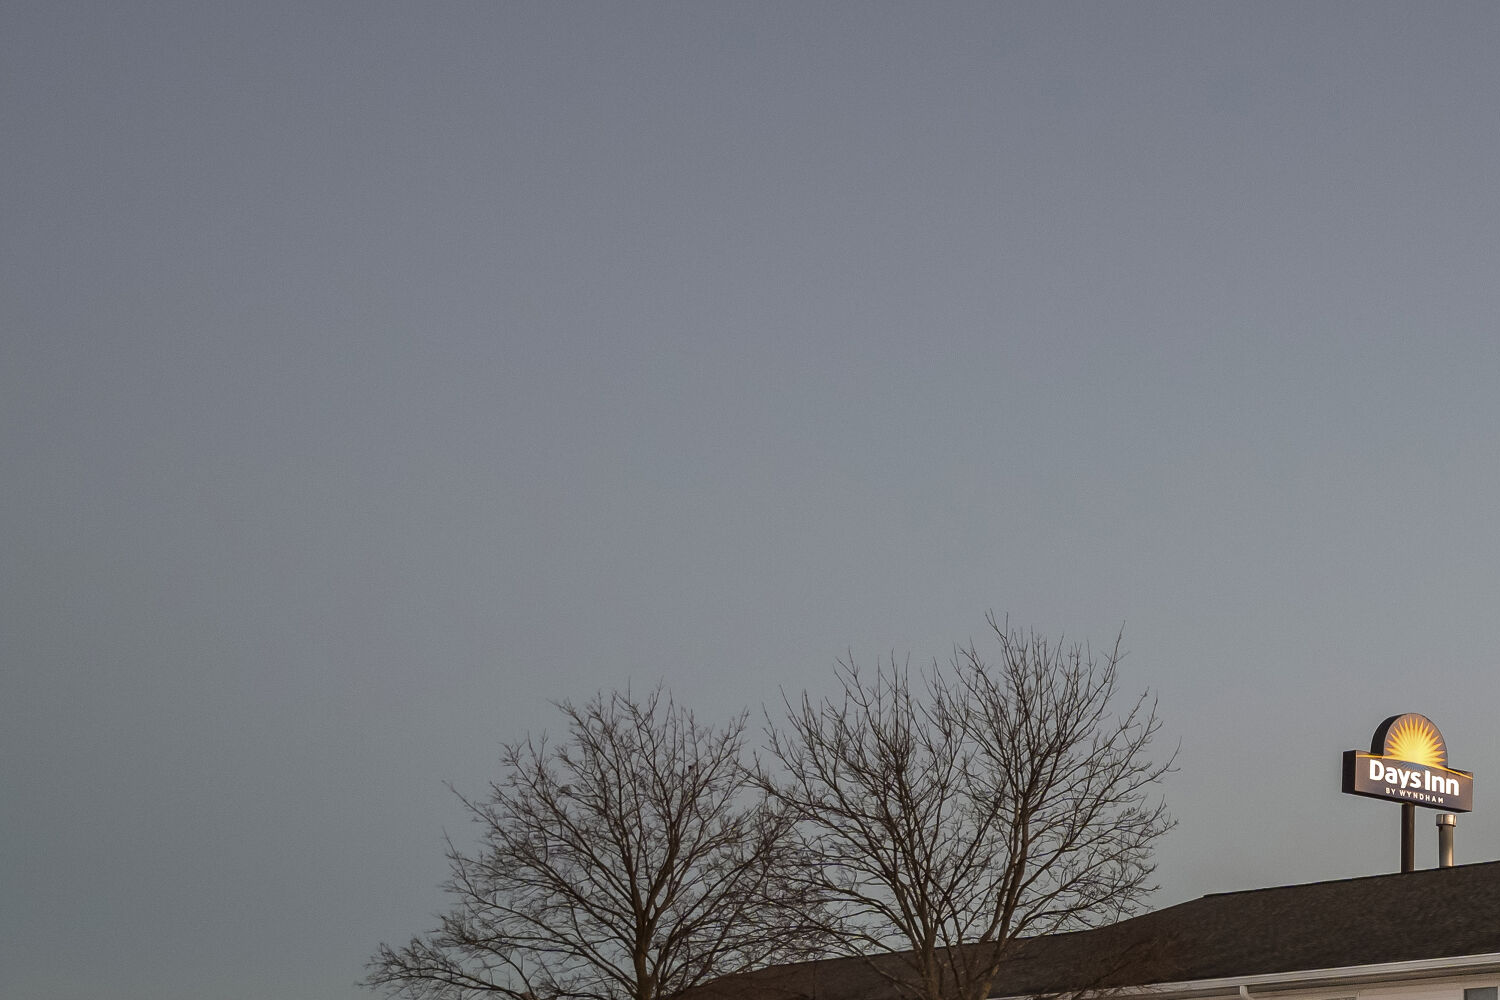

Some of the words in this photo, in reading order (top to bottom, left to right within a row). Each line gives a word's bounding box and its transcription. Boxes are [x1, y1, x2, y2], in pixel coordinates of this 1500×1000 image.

[1369, 759, 1421, 789] Days
[1424, 770, 1460, 796] Inn
[1385, 787, 1396, 795] BY
[1399, 789, 1444, 804] WYNDHAM
